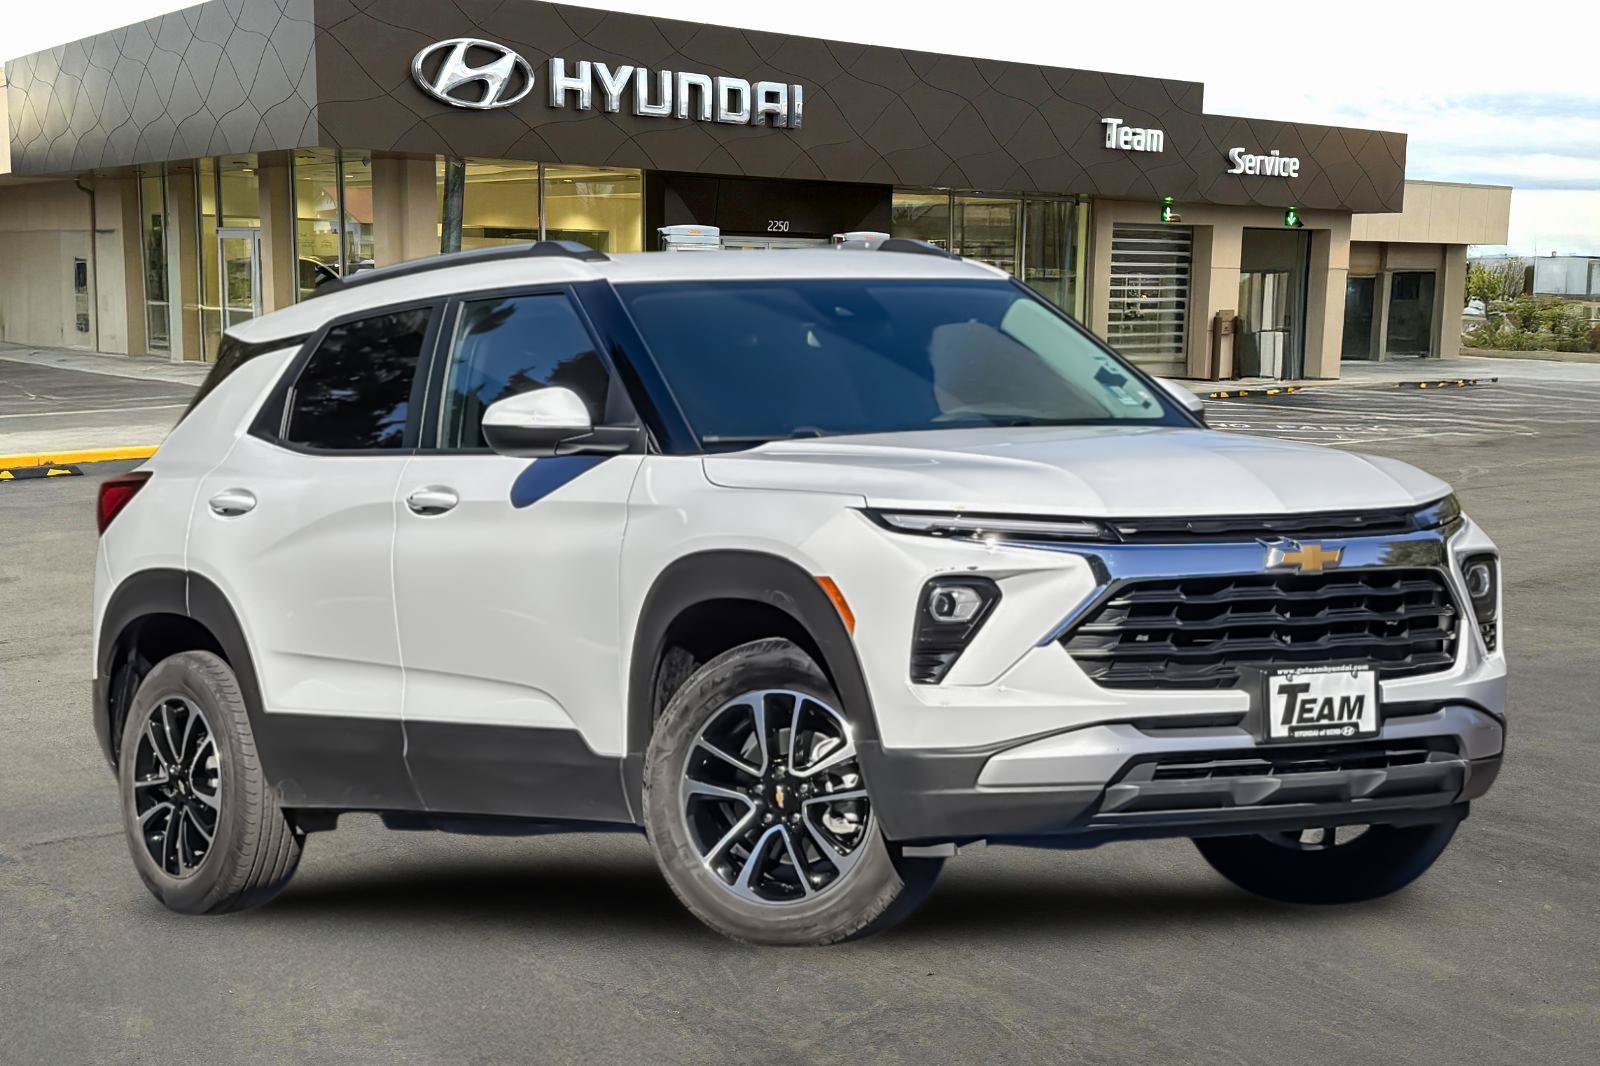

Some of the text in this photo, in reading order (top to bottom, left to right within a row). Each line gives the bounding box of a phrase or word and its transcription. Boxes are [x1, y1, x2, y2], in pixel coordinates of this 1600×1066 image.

[549, 57, 803, 129] HYUNDAI
[1101, 117, 1164, 153] Team
[1227, 147, 1300, 178] Service
[767, 220, 790, 232] 2250
[1277, 683, 1365, 725] TEAM
